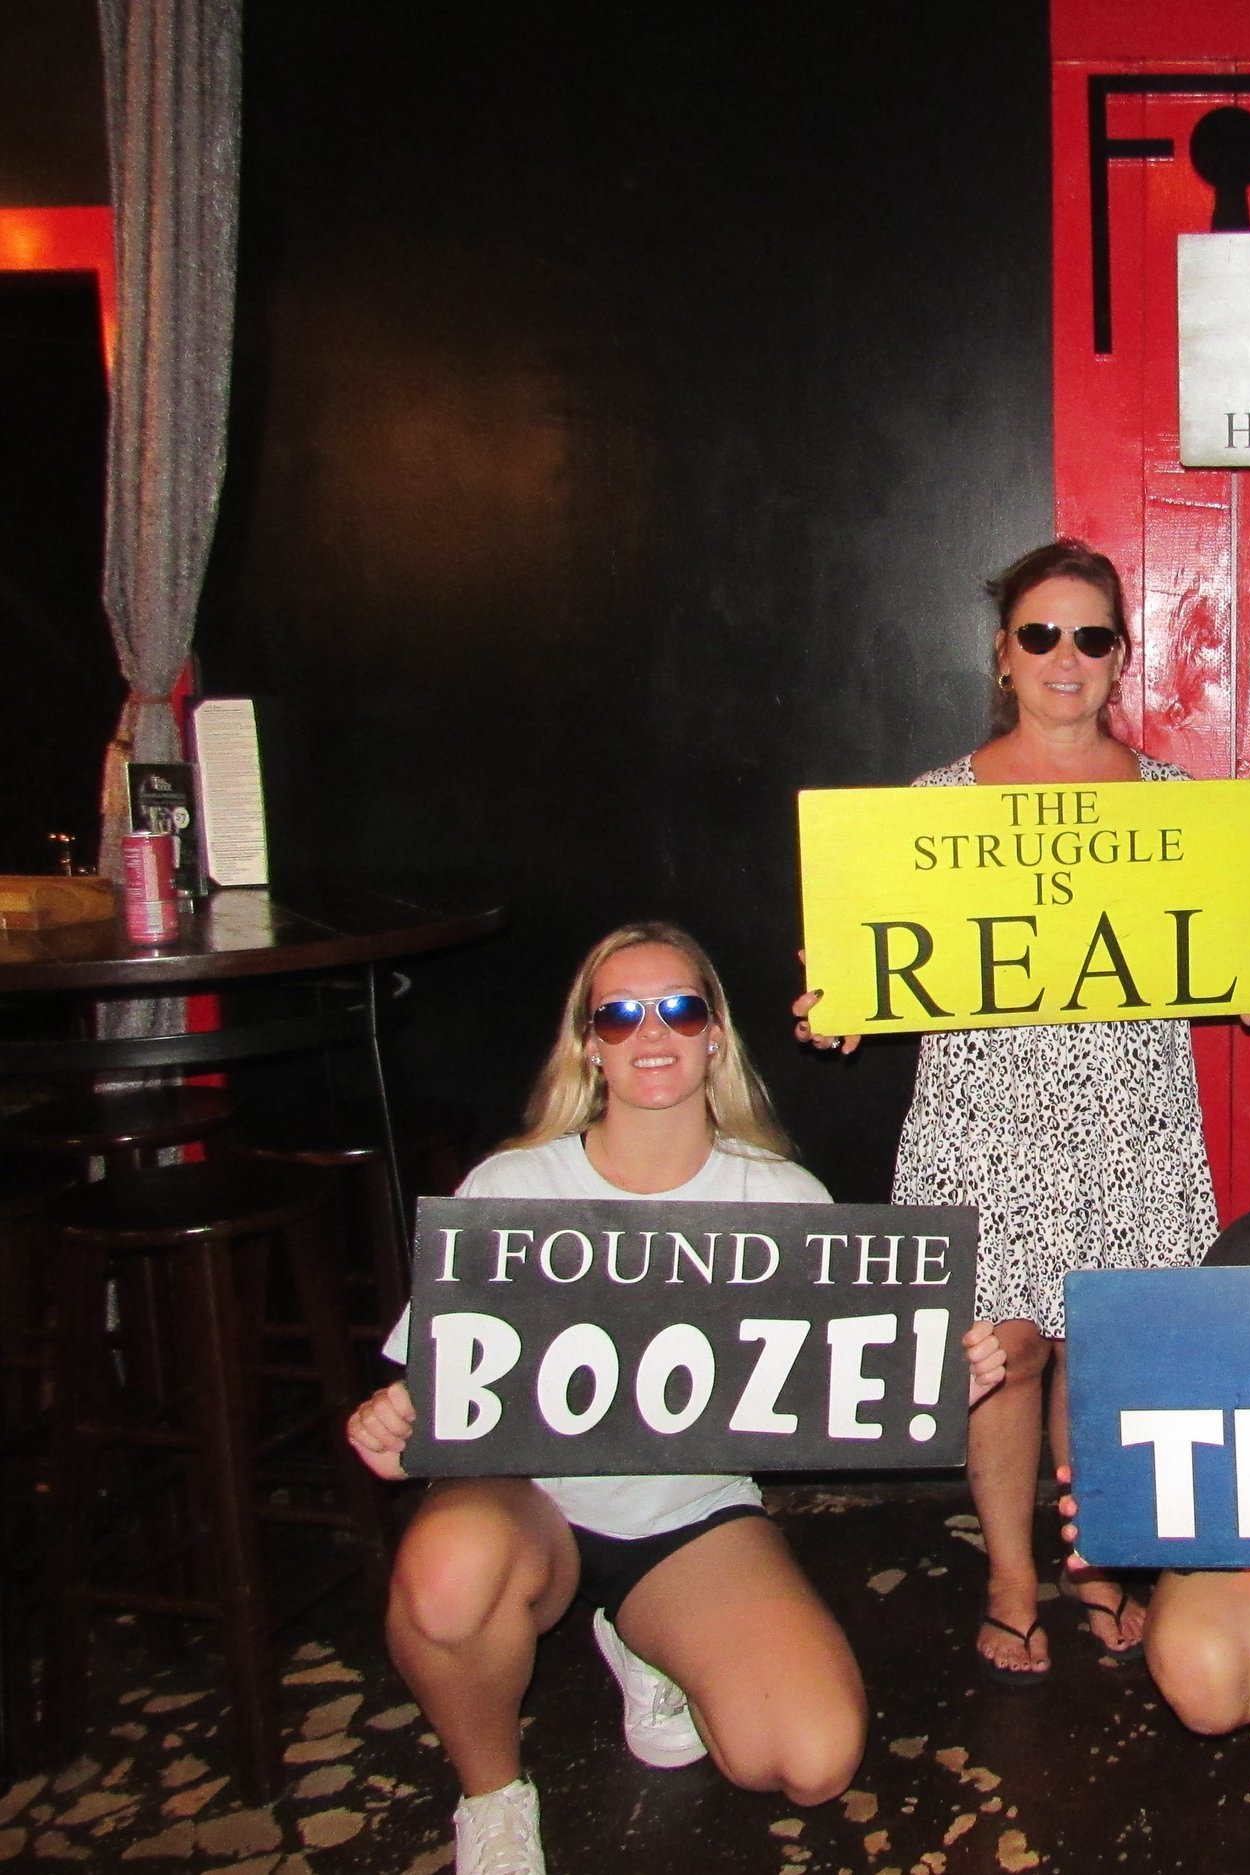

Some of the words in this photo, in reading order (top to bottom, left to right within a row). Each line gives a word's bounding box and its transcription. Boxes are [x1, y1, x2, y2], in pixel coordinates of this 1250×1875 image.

[1001, 790, 1100, 826] THE
[914, 828, 1185, 871] STRUGGLE
[1033, 871, 1074, 906] IS
[861, 908, 1238, 1022] REAL
[435, 1228, 465, 1283] I
[488, 1228, 780, 1284] FOUND
[805, 1233, 952, 1286] THE
[431, 1307, 949, 1442] BOOZE!
